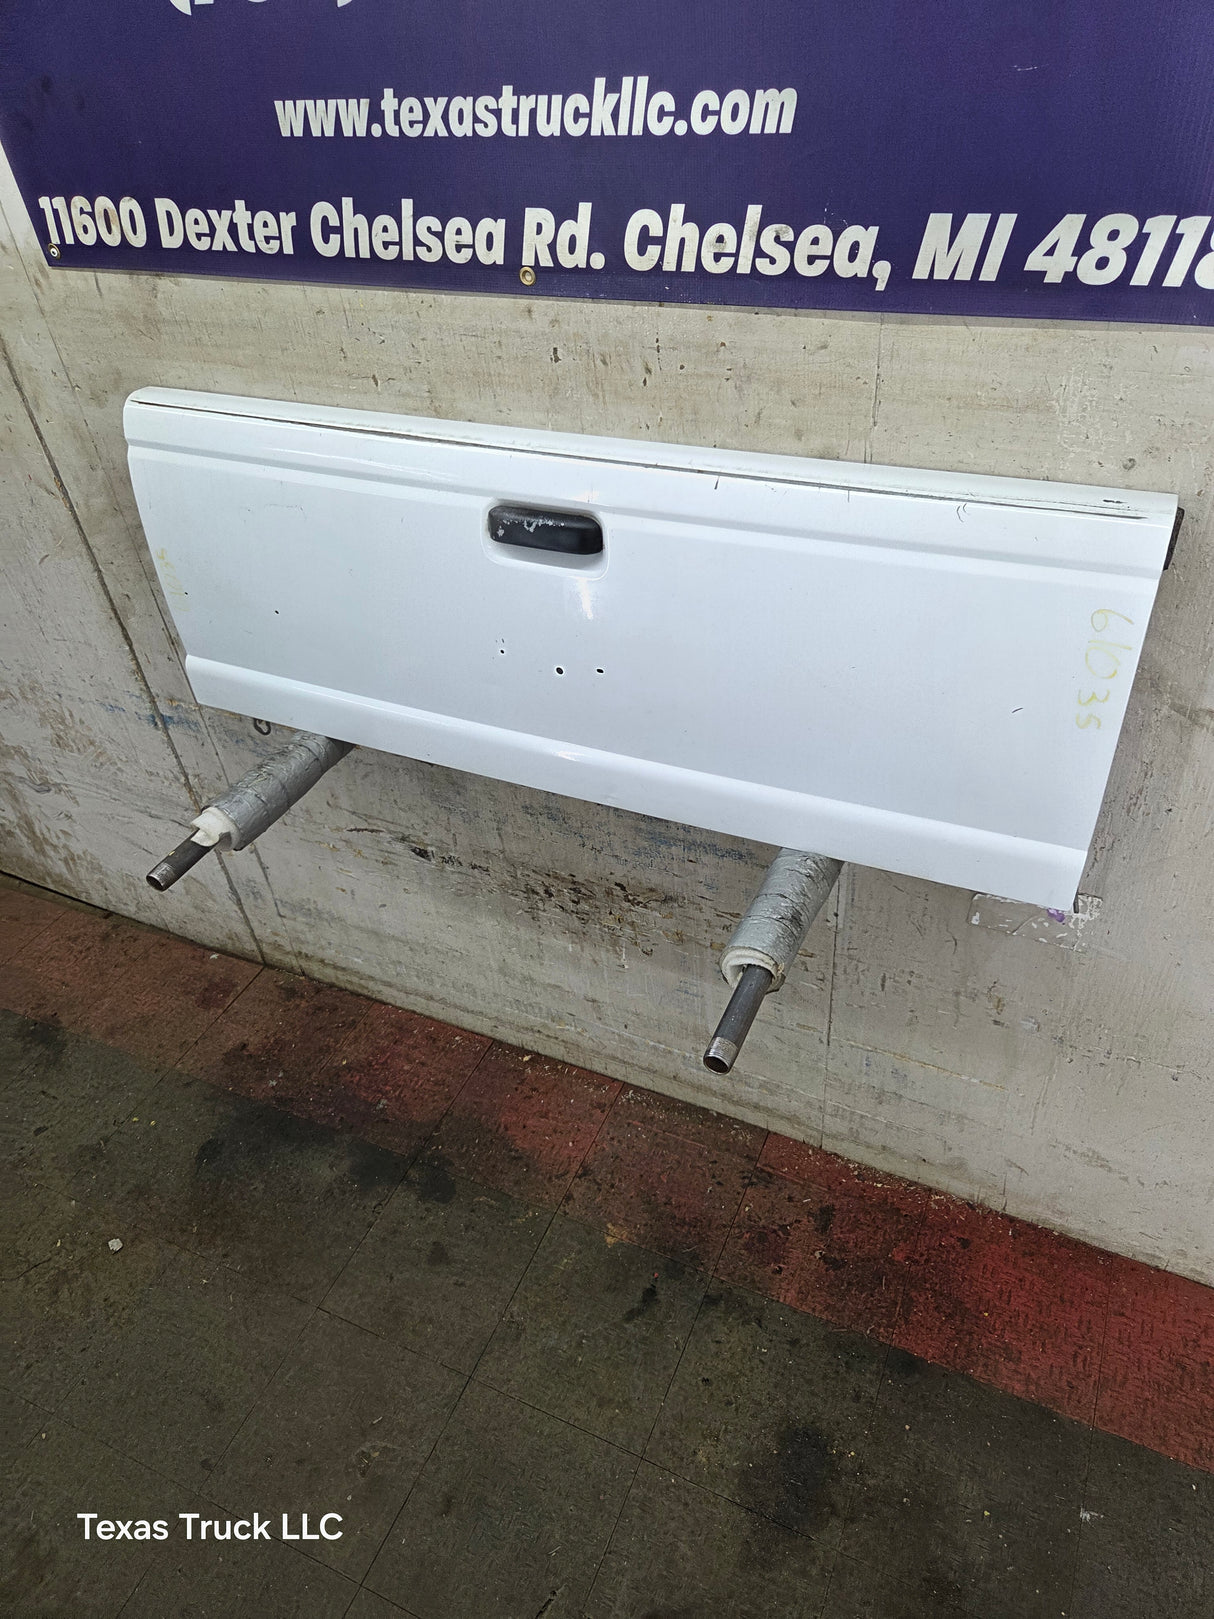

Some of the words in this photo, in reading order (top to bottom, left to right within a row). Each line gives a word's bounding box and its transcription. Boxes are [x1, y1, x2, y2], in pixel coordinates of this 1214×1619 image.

[274, 76, 797, 138] www.texastruckllc.com
[38, 196, 147, 248] 11600
[155, 197, 297, 255] Dexter
[310, 197, 506, 265] Chelsea
[522, 202, 606, 269] Rd.
[624, 204, 892, 291] Chelsea,
[912, 213, 1017, 282] MI
